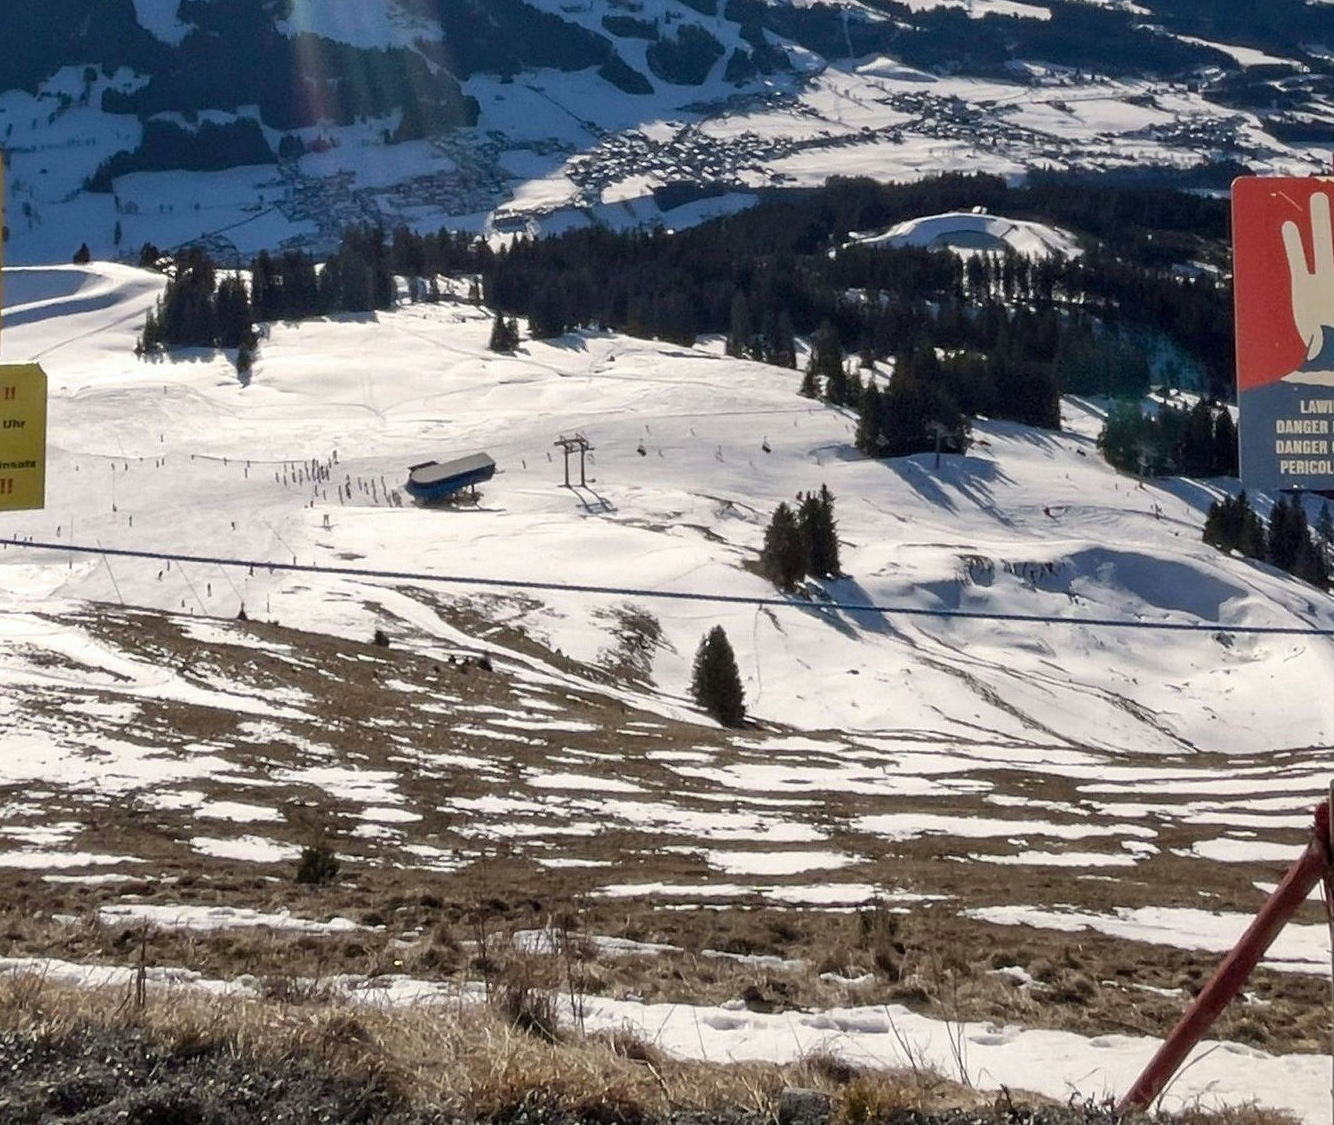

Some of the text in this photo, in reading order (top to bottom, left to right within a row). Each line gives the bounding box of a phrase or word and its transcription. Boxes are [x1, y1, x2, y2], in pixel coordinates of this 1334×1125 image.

[3, 419, 26, 430] Uhr
[1275, 419, 1329, 434] DANGER
[1275, 439, 1328, 454] DANGER
